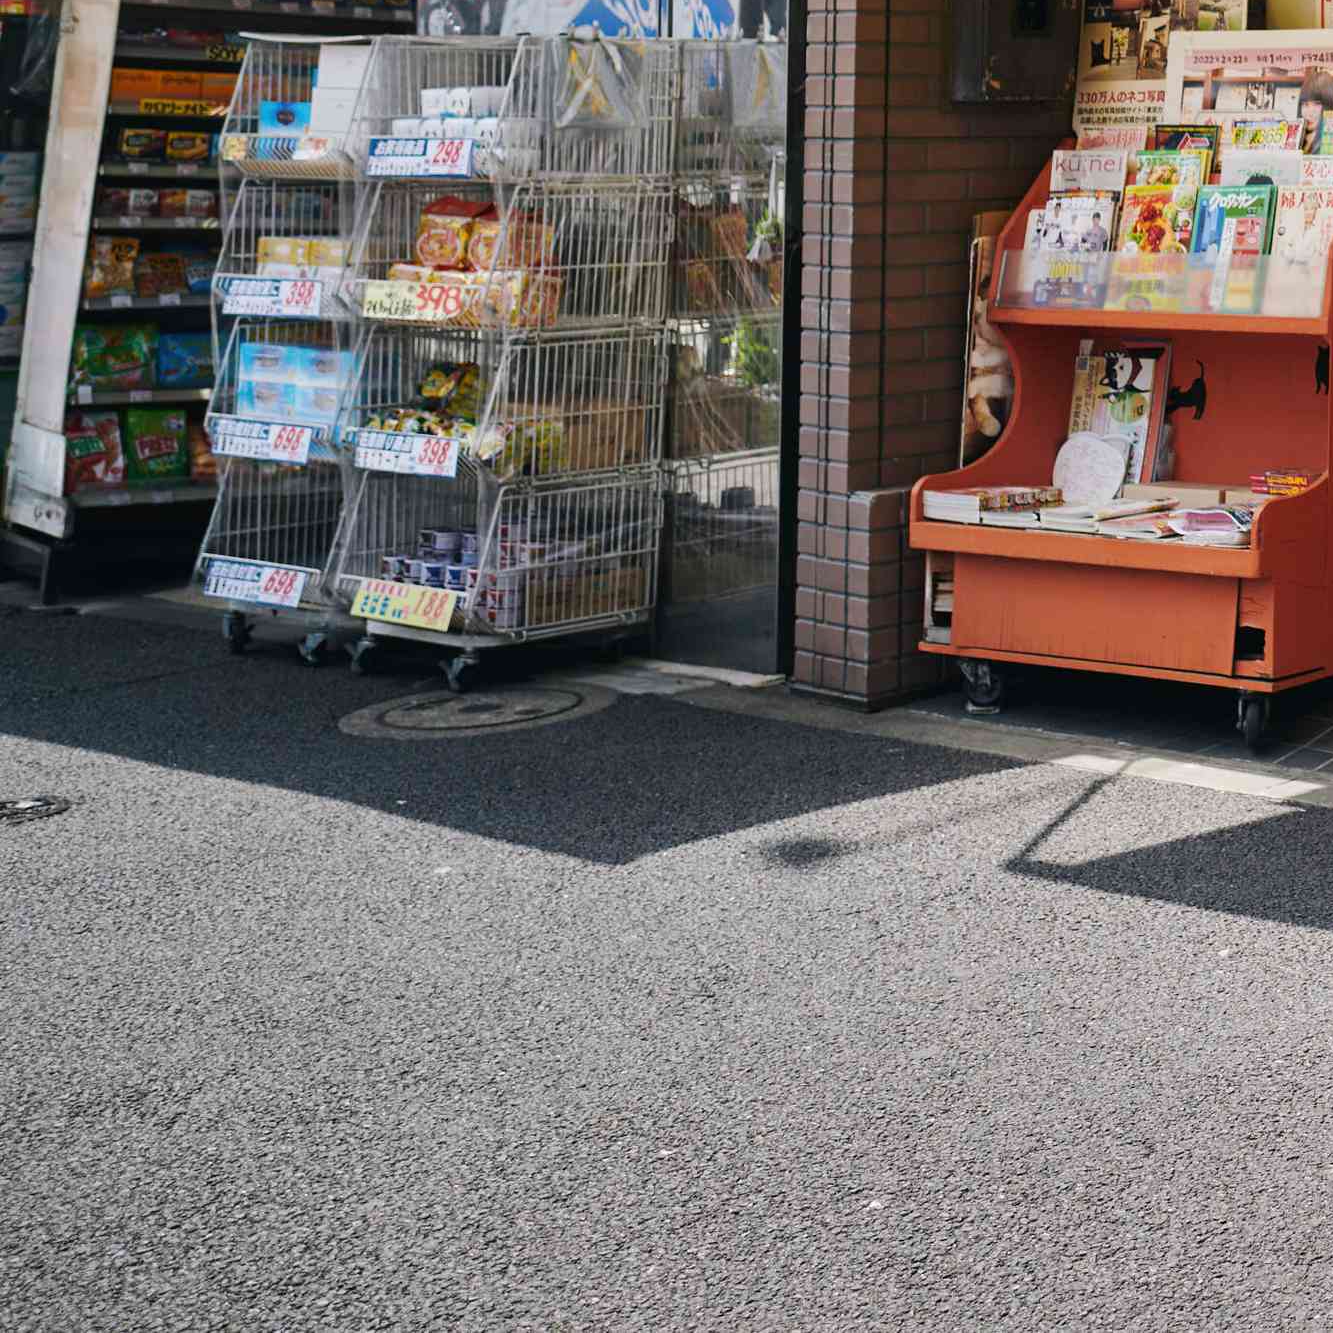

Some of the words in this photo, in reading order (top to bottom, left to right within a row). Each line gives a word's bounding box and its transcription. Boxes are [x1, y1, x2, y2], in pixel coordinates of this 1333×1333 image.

[430, 141, 464, 164] 298
[1209, 192, 1259, 209] クロワッサン
[415, 282, 464, 315] 398
[273, 426, 305, 450] 698
[417, 439, 450, 464] 398
[264, 572, 298, 595] 698
[412, 590, 449, 617] 188
